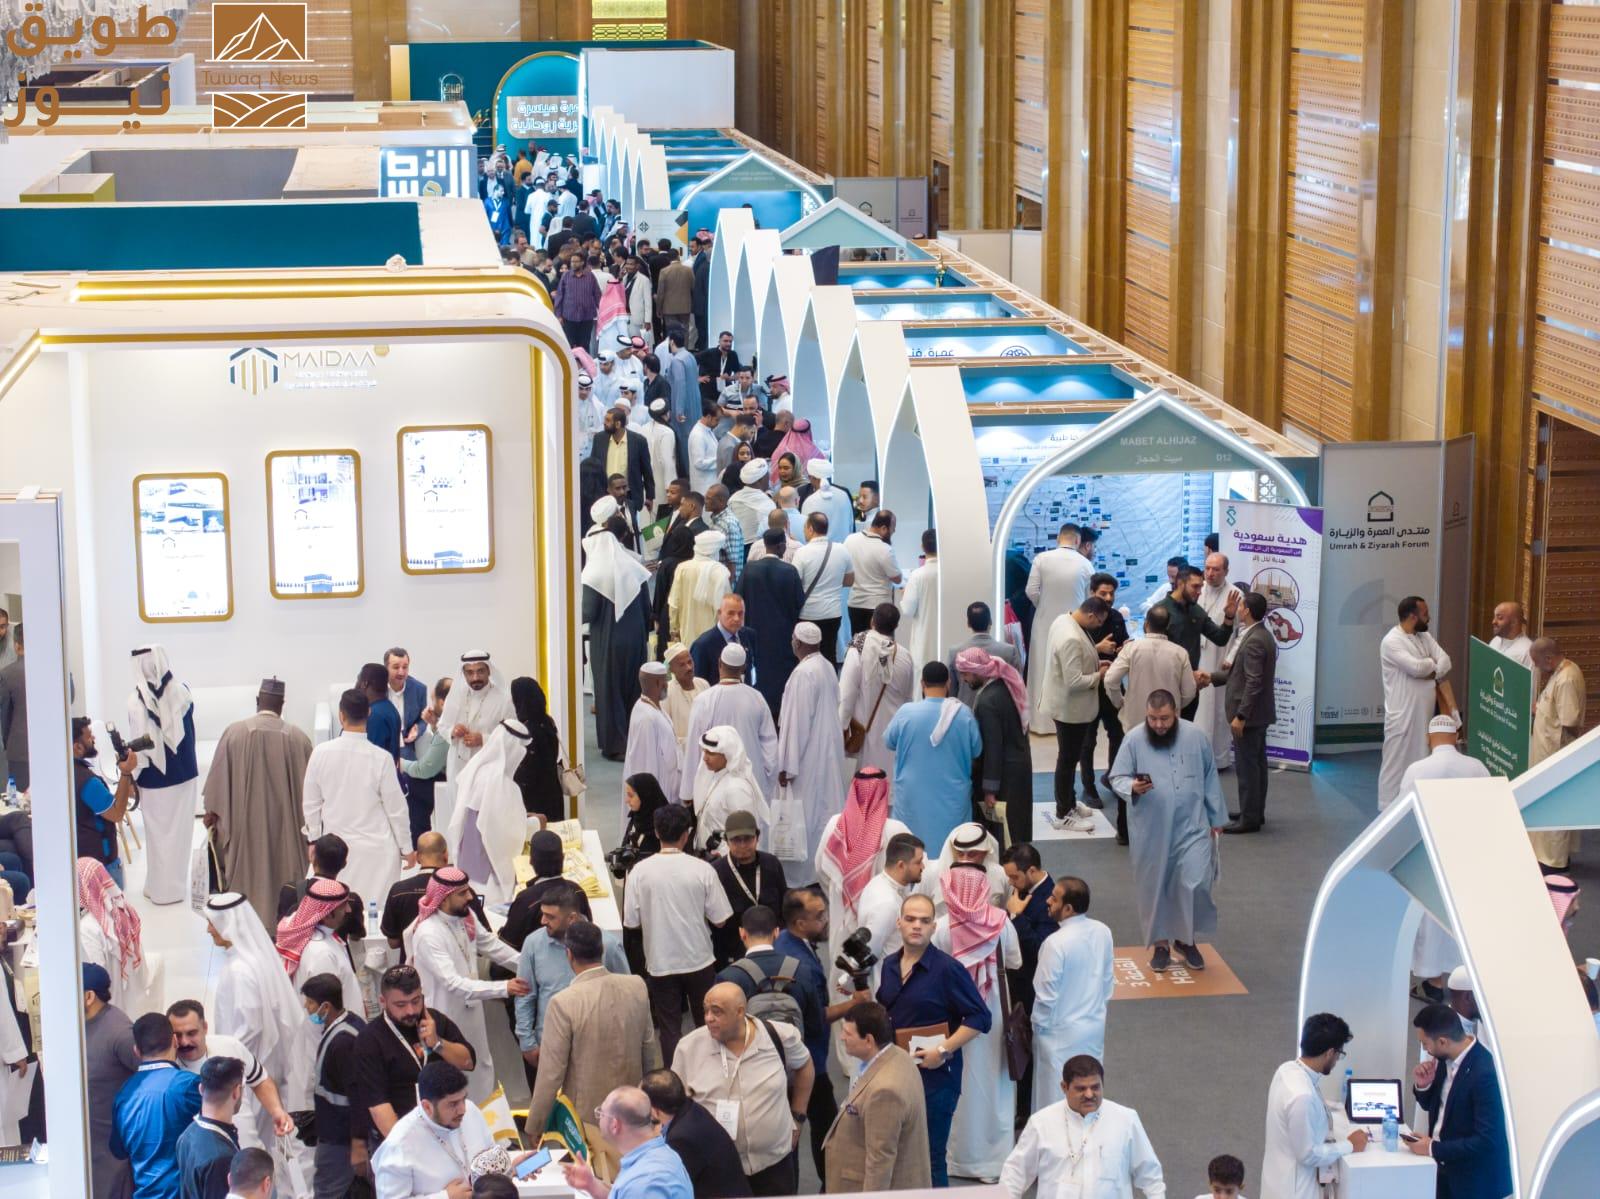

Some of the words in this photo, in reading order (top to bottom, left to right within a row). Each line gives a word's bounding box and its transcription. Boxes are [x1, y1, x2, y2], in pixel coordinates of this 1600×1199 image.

[284, 351, 376, 368] MAIDAA
[1120, 436, 1153, 446] MABET
[1156, 435, 1198, 446] ALHIJAZ
[1233, 529, 1275, 543] سعودية
[1329, 527, 1366, 540] والزيارة
[1367, 526, 1395, 539] العمرة
[1397, 526, 1430, 538] منتدى
[1277, 533, 1307, 546] هدية
[1329, 542, 1358, 551] Umrah
[1359, 542, 1367, 550] &
[1367, 541, 1400, 551] Ziyarah
[1402, 540, 1430, 549] Forum
